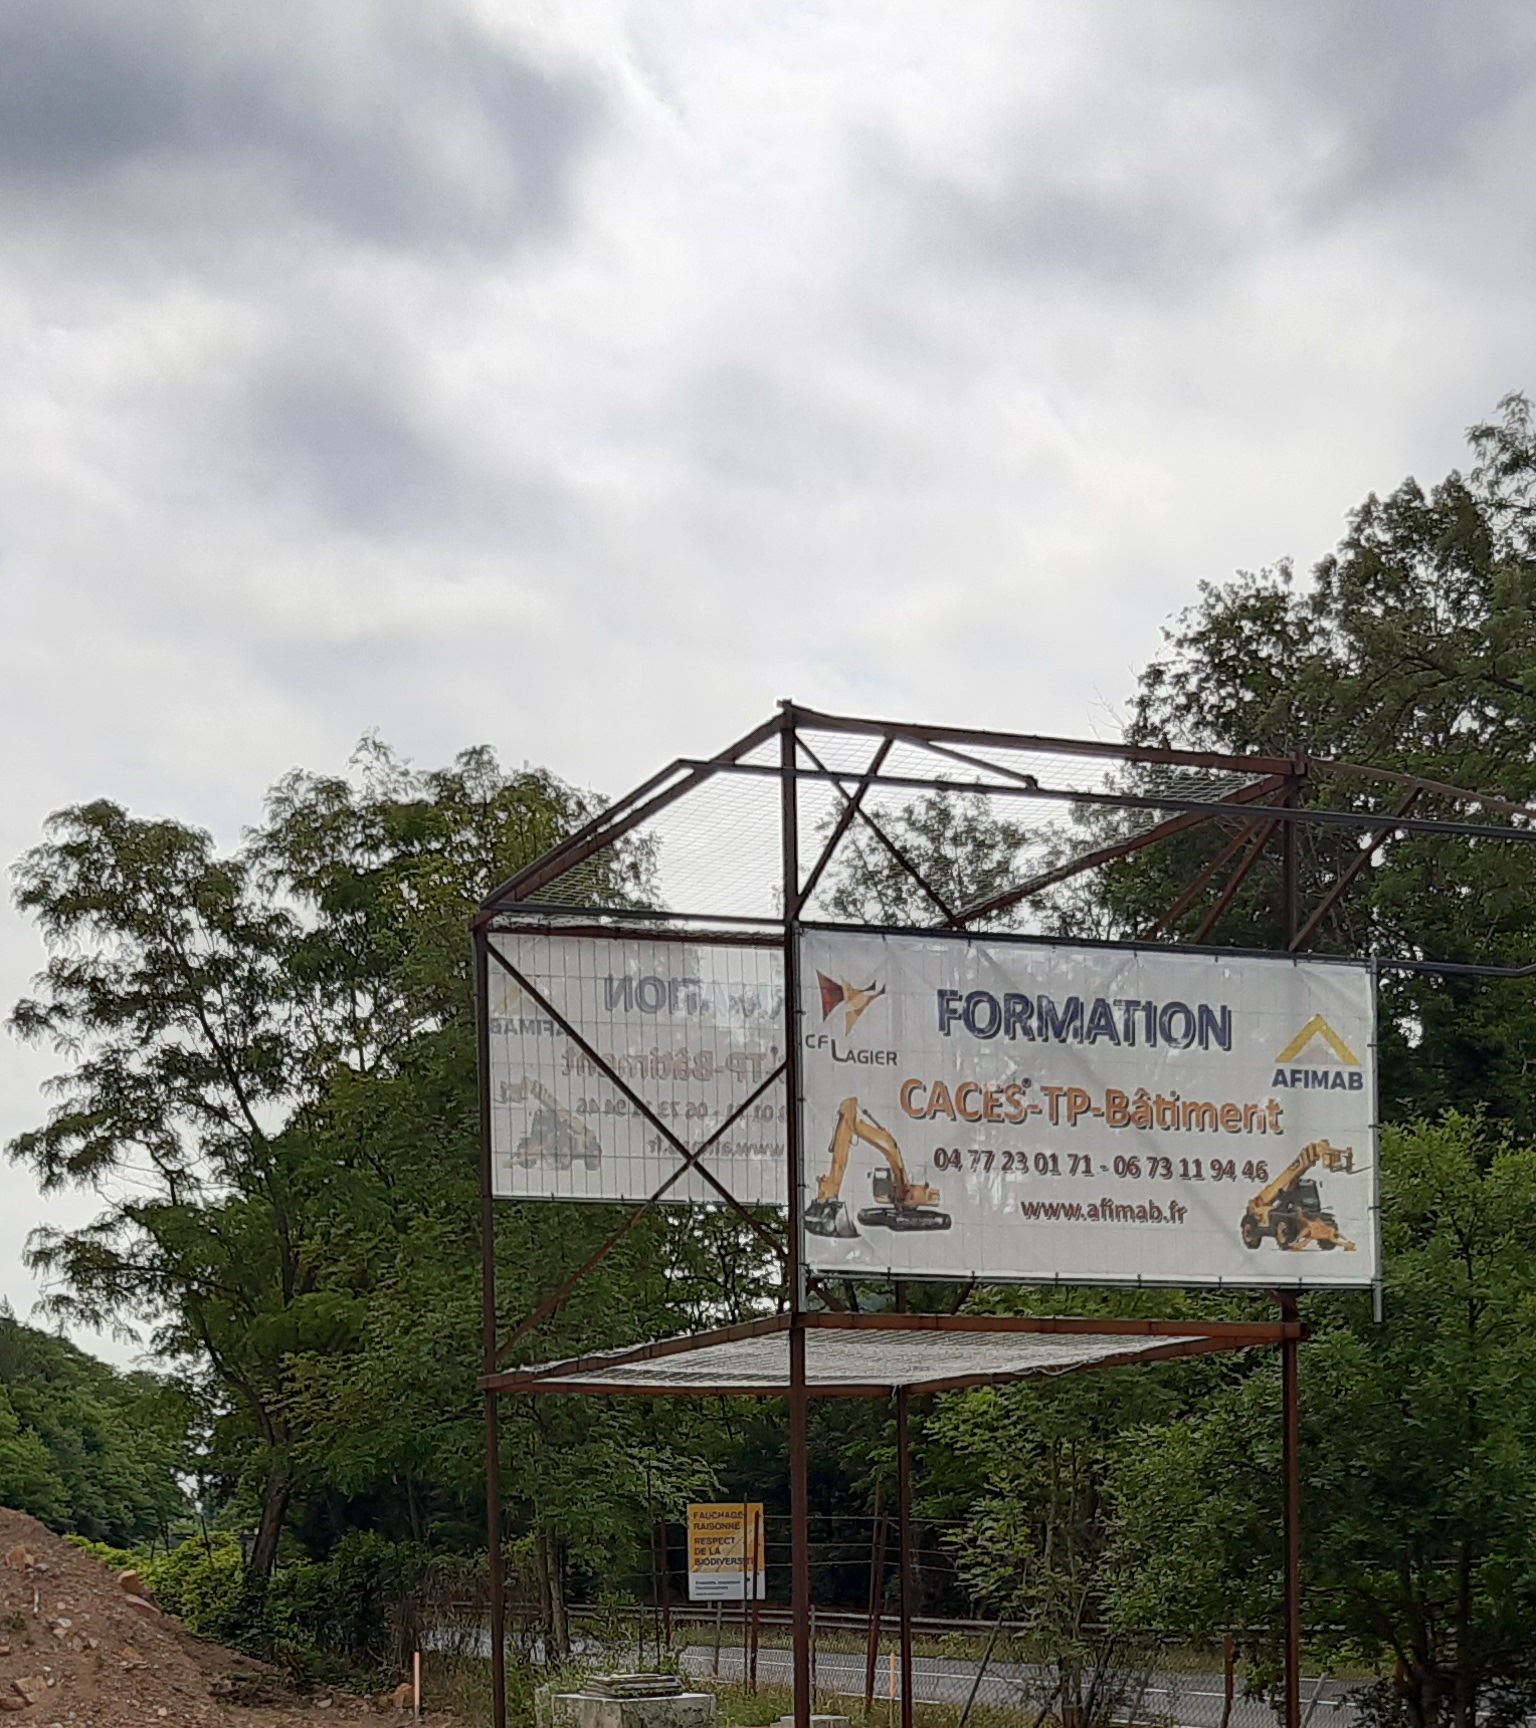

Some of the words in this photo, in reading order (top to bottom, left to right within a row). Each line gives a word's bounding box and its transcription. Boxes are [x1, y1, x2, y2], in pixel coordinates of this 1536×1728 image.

[937, 989, 1232, 1051] FORMATION
[805, 1034, 828, 1049] CF
[831, 1039, 898, 1066] LAGIER
[1271, 1068, 1363, 1092] AFIMAB
[934, 1148, 962, 1173] 04
[967, 1149, 995, 1173] 77
[1001, 1150, 1029, 1175] 23
[1034, 1152, 1062, 1176] 01
[1067, 1153, 1095, 1177] 71
[1113, 1155, 1142, 1179] 06
[1146, 1156, 1173, 1180] 73
[1179, 1158, 1206, 1181] 11
[1210, 1159, 1240, 1183] 94
[1242, 1160, 1269, 1184] 46
[1020, 1197, 1187, 1224] www.afimab.fr
[694, 1536, 736, 1545] RESPECT
[694, 1547, 706, 1556] DE
[709, 1547, 722, 1555] LA
